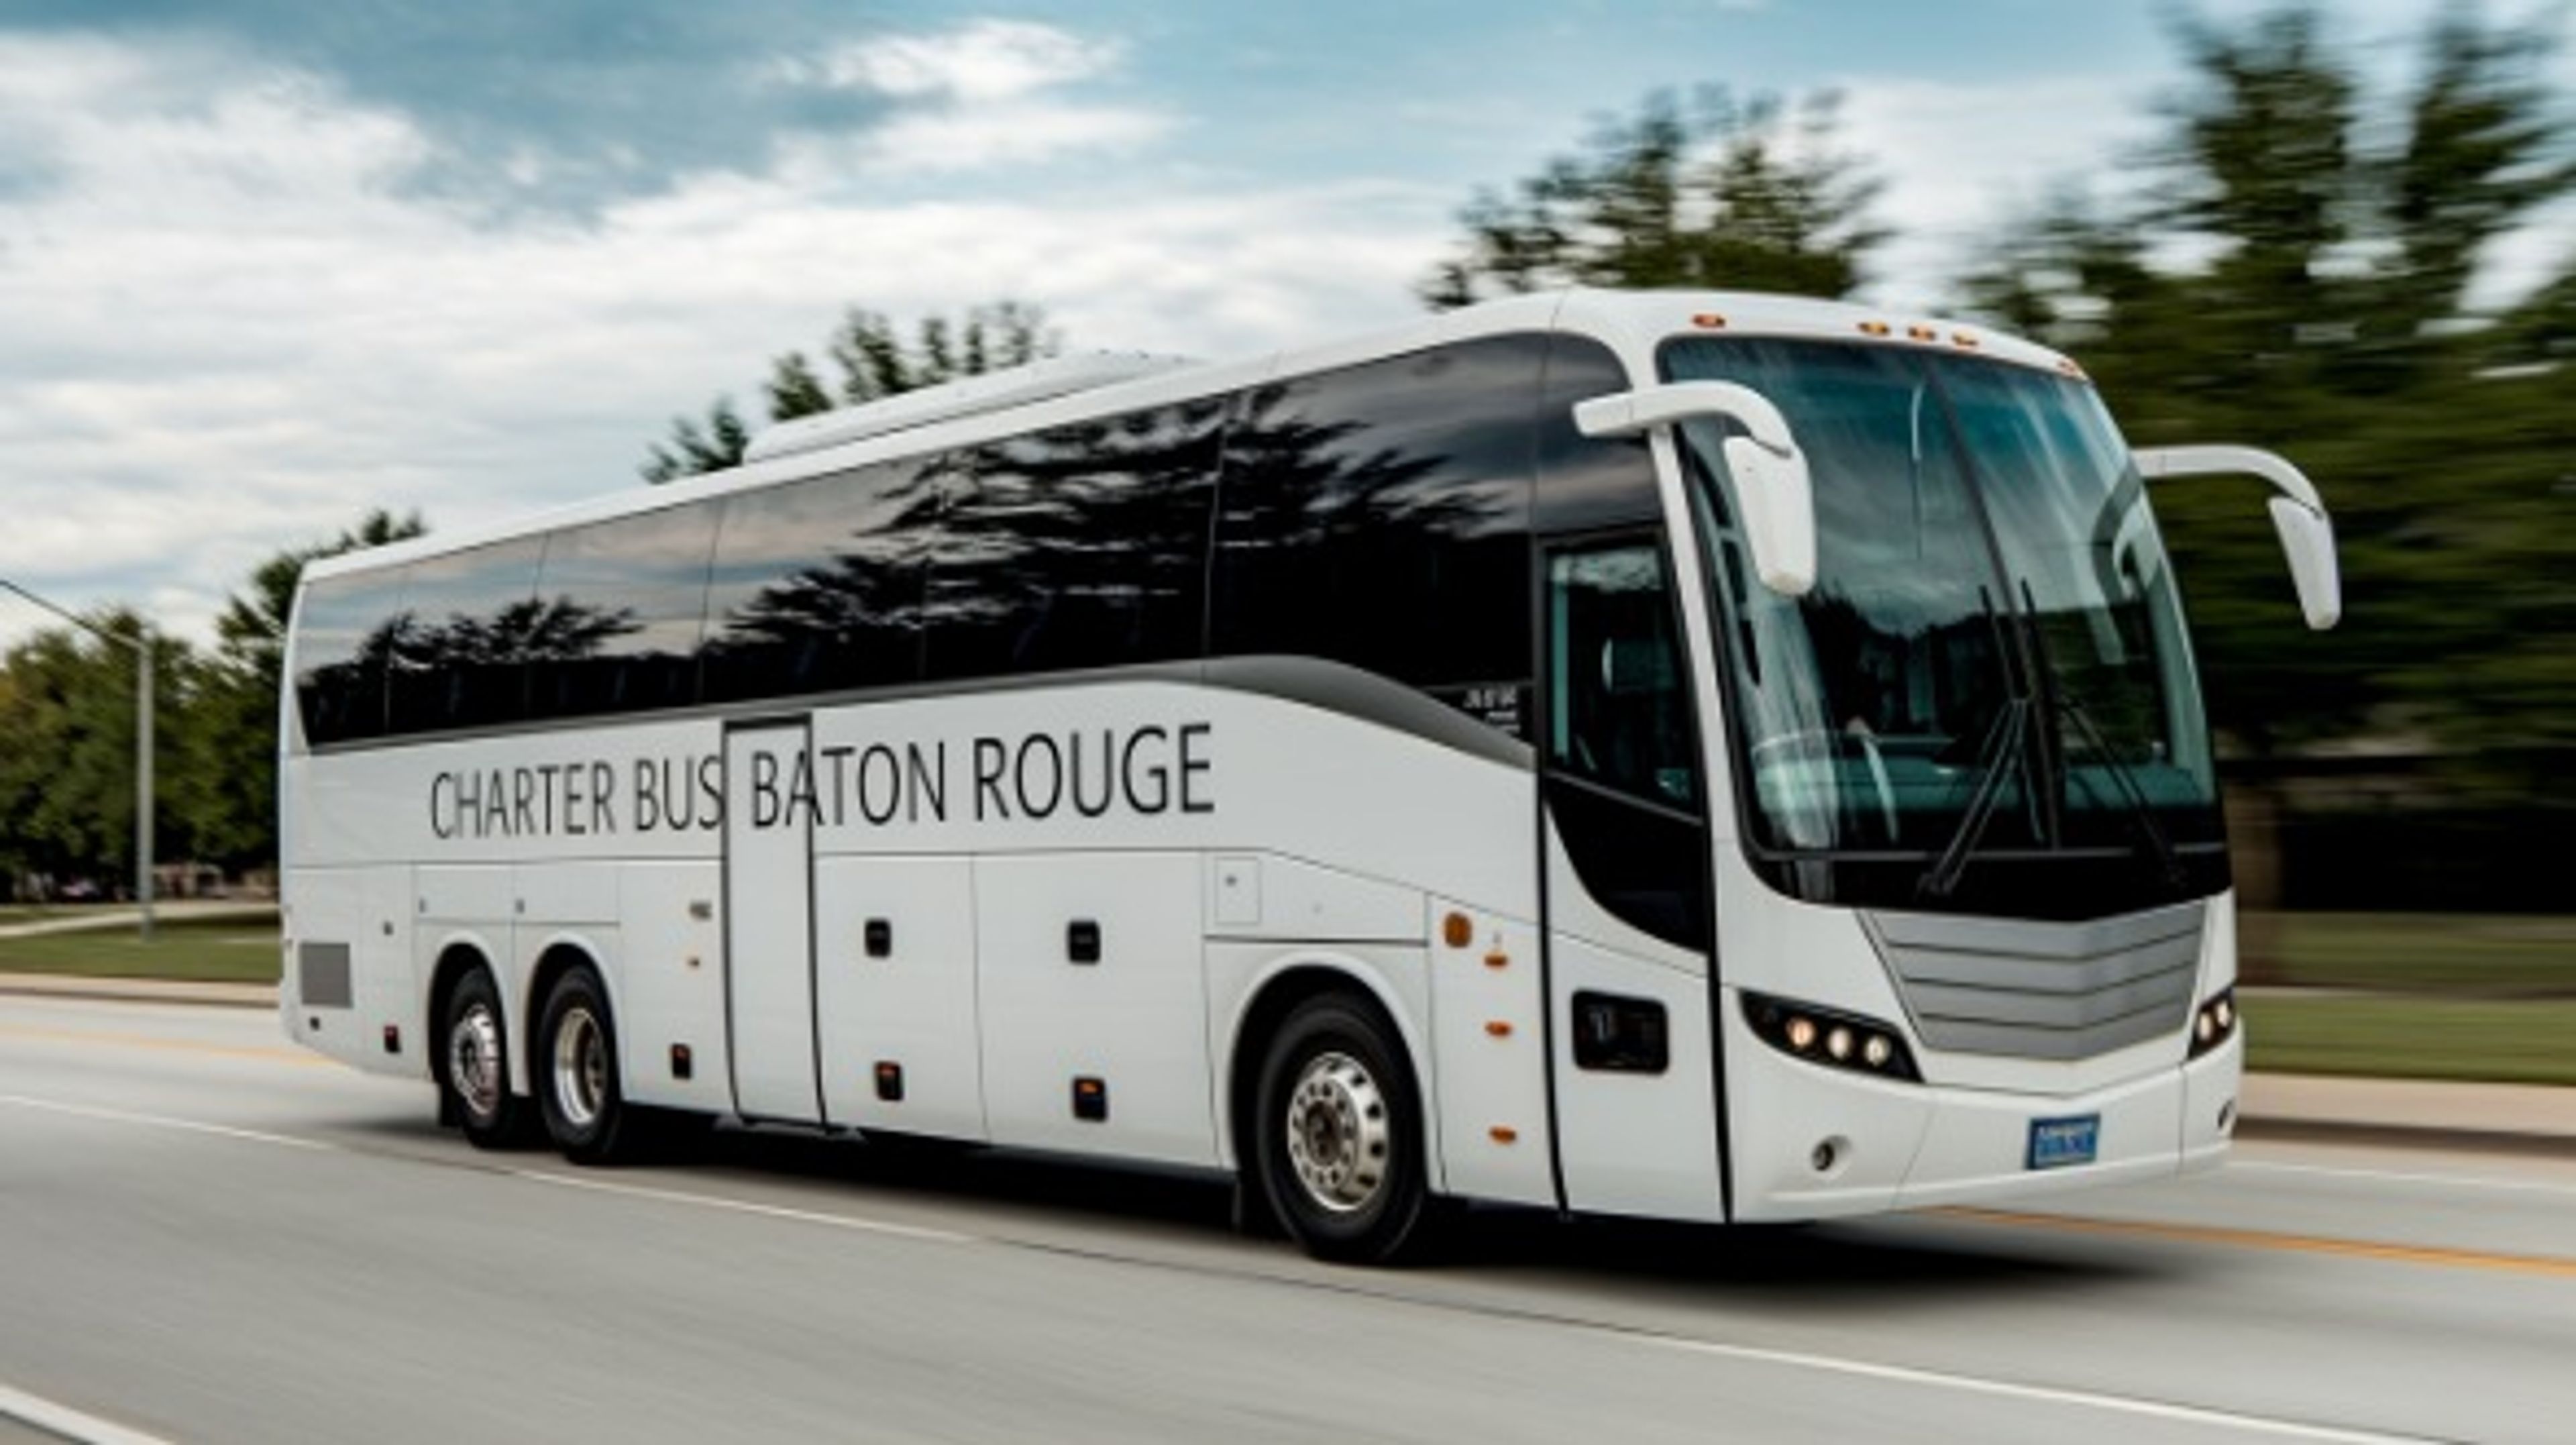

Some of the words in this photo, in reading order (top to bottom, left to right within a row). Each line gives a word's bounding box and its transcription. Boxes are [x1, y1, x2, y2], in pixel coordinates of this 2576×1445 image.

[431, 761, 616, 839] CHARTER
[633, 754, 725, 831] BUS
[752, 741, 946, 828] BATON
[973, 722, 1215, 822] ROUGE
